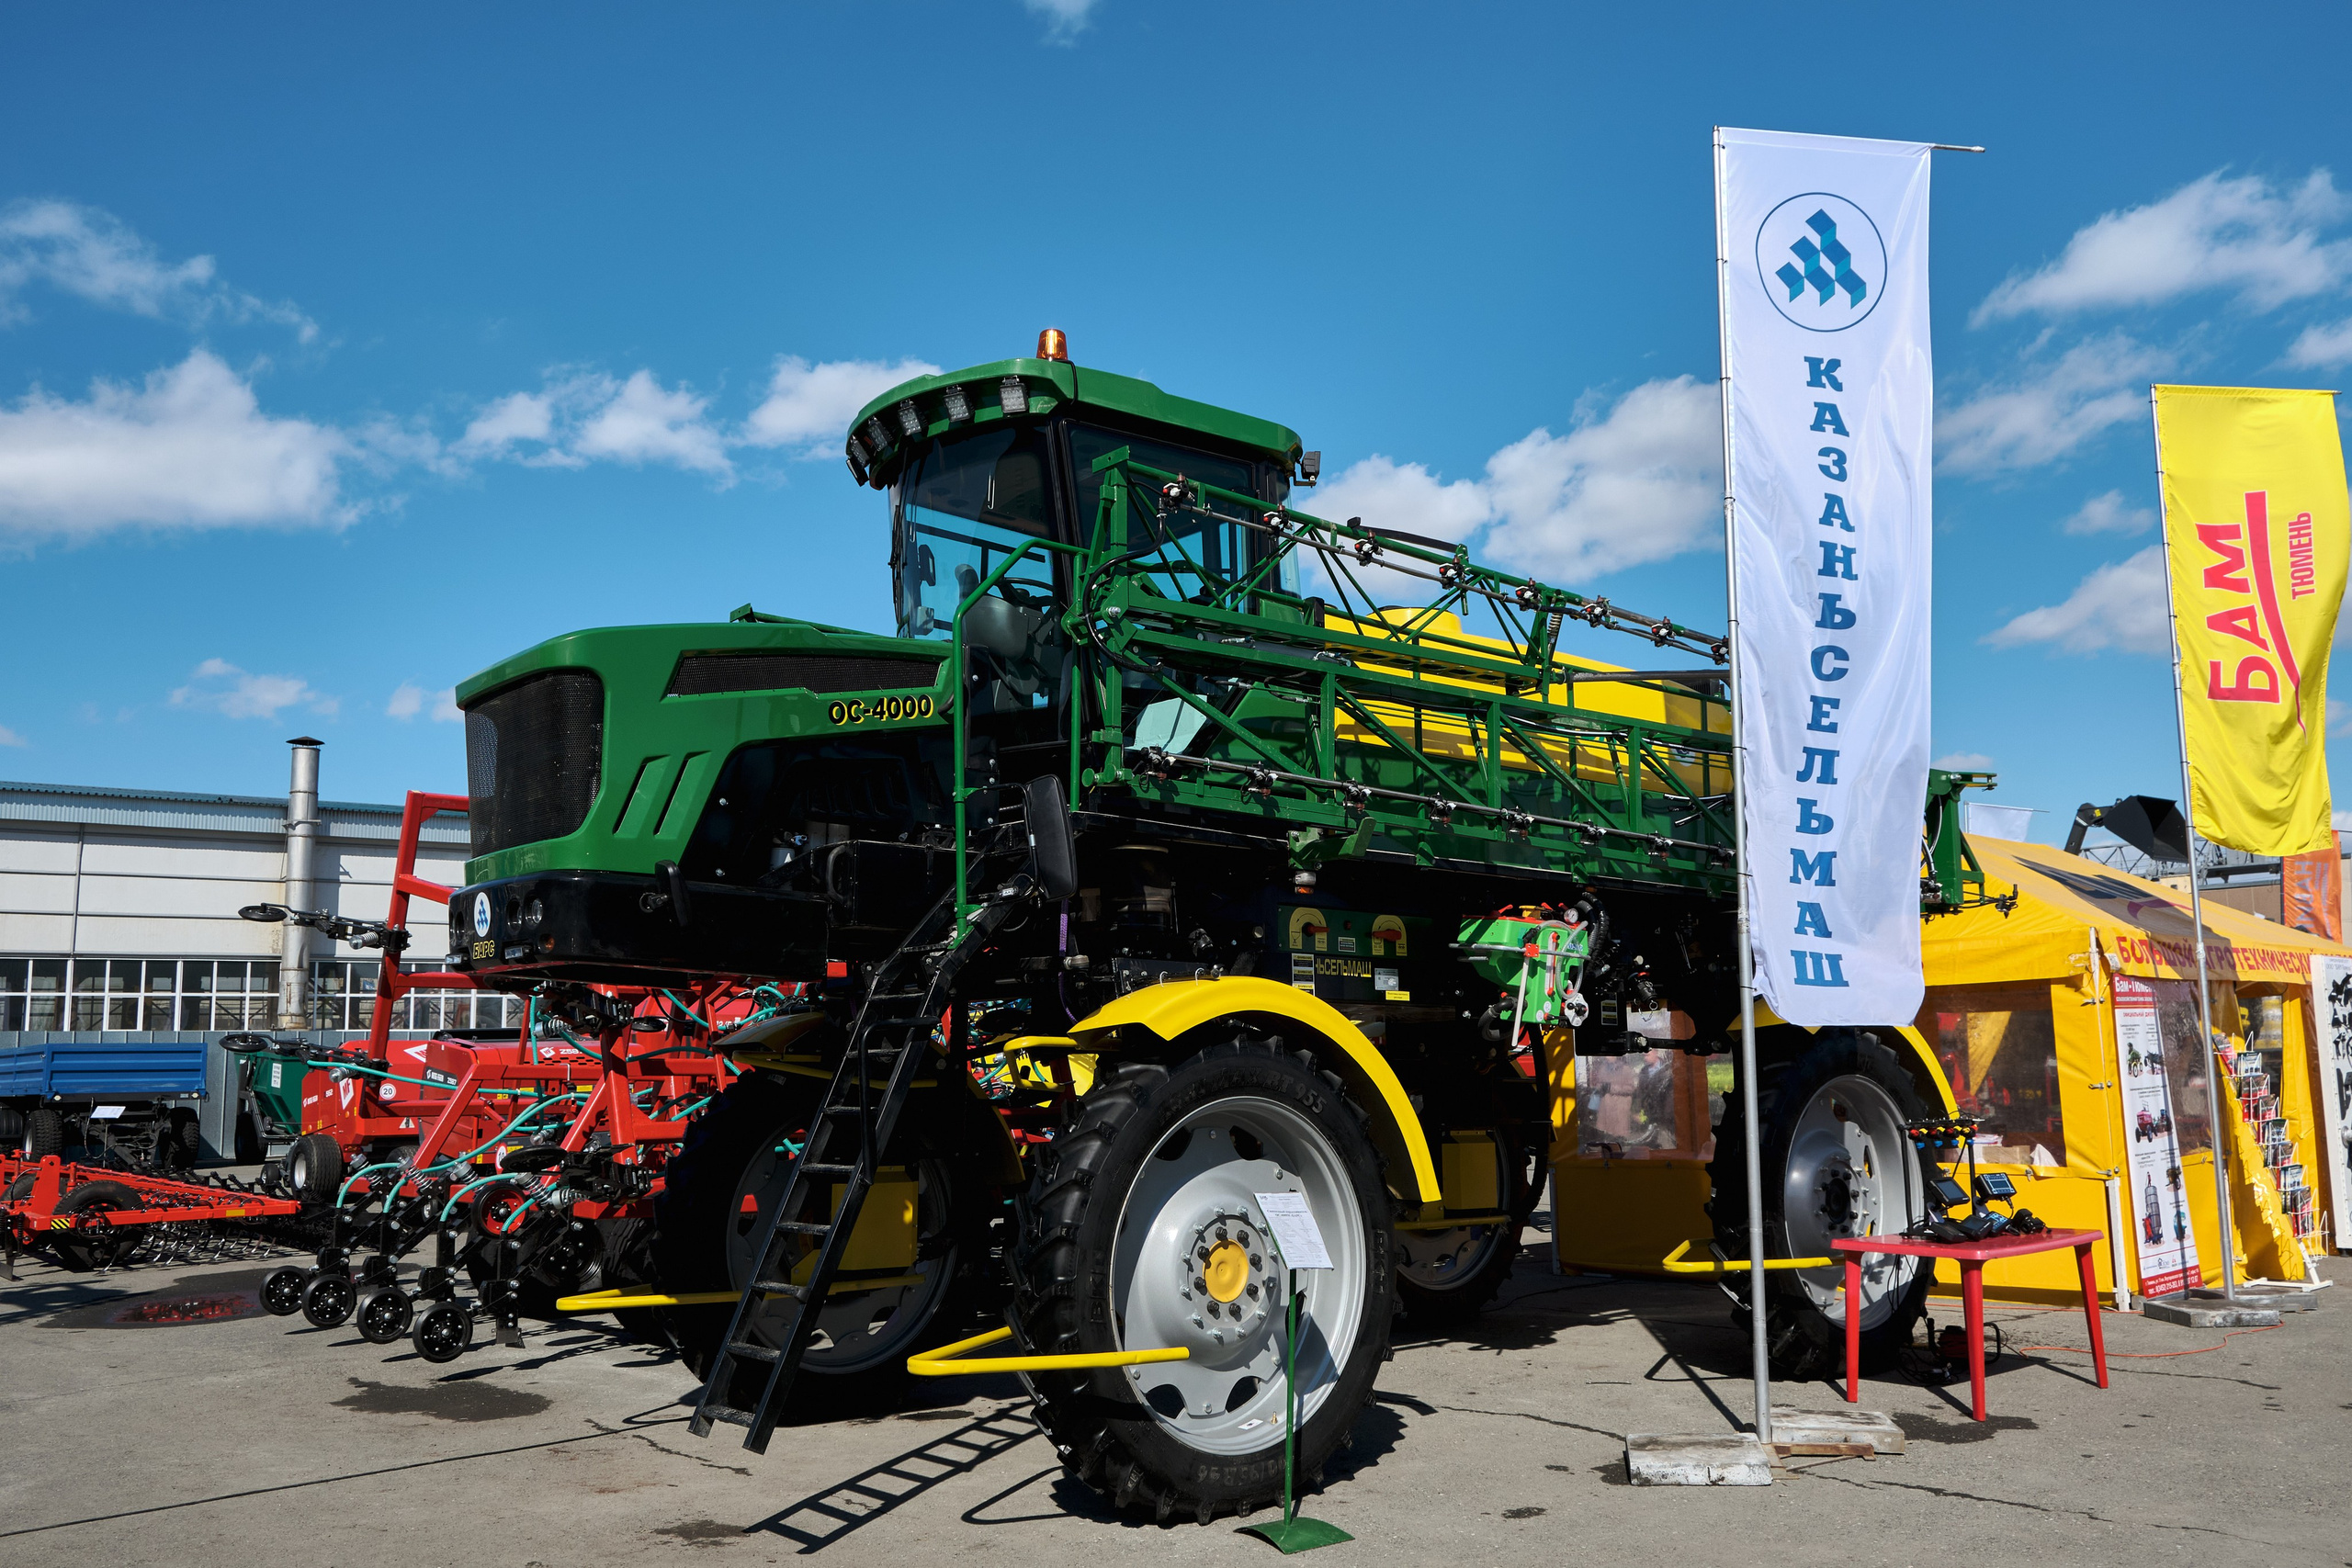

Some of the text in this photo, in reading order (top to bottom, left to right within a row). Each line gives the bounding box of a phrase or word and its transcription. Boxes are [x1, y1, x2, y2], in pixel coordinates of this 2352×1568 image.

[2288, 511, 2315, 601] ТЮМЕНЬ
[2194, 522, 2280, 705] БАМ
[1789, 355, 1859, 987] КАЗАНЬСЕЛЬМАШ
[828, 694, 934, 726] ОС-4000
[472, 940, 495, 960] БАРС
[2115, 936, 2198, 968] БОЛЬШОЙ
[2202, 945, 2316, 975] ГРОТЕХНИЧЕСКИ
[383, 1088, 393, 1096] 20
